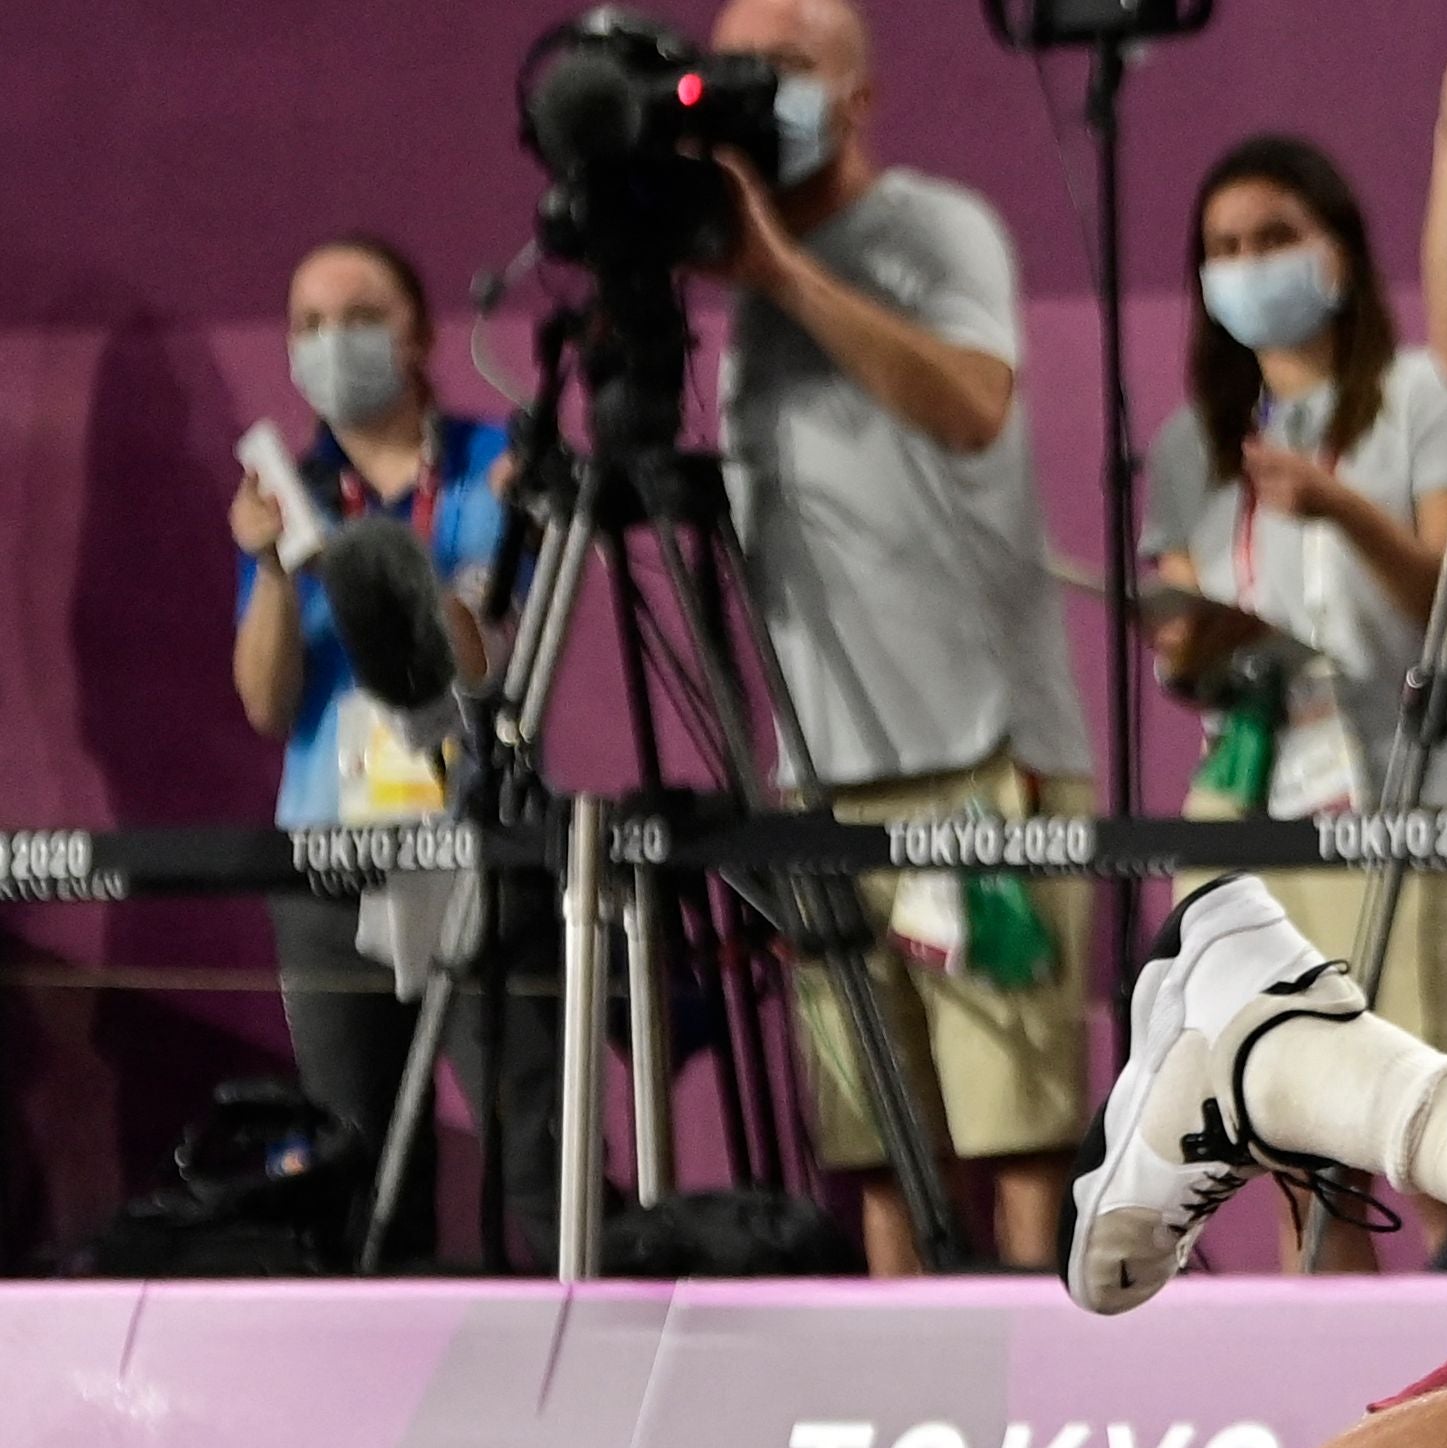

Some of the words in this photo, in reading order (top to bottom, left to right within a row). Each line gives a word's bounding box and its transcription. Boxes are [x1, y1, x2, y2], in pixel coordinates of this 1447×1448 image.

[10, 830, 92, 879] 2020
[288, 826, 394, 872] TOKYO
[397, 823, 473, 871] 2020
[884, 817, 1001, 868] TOKYO
[1003, 815, 1093, 866] 2020
[1313, 809, 1436, 861] TOKYO
